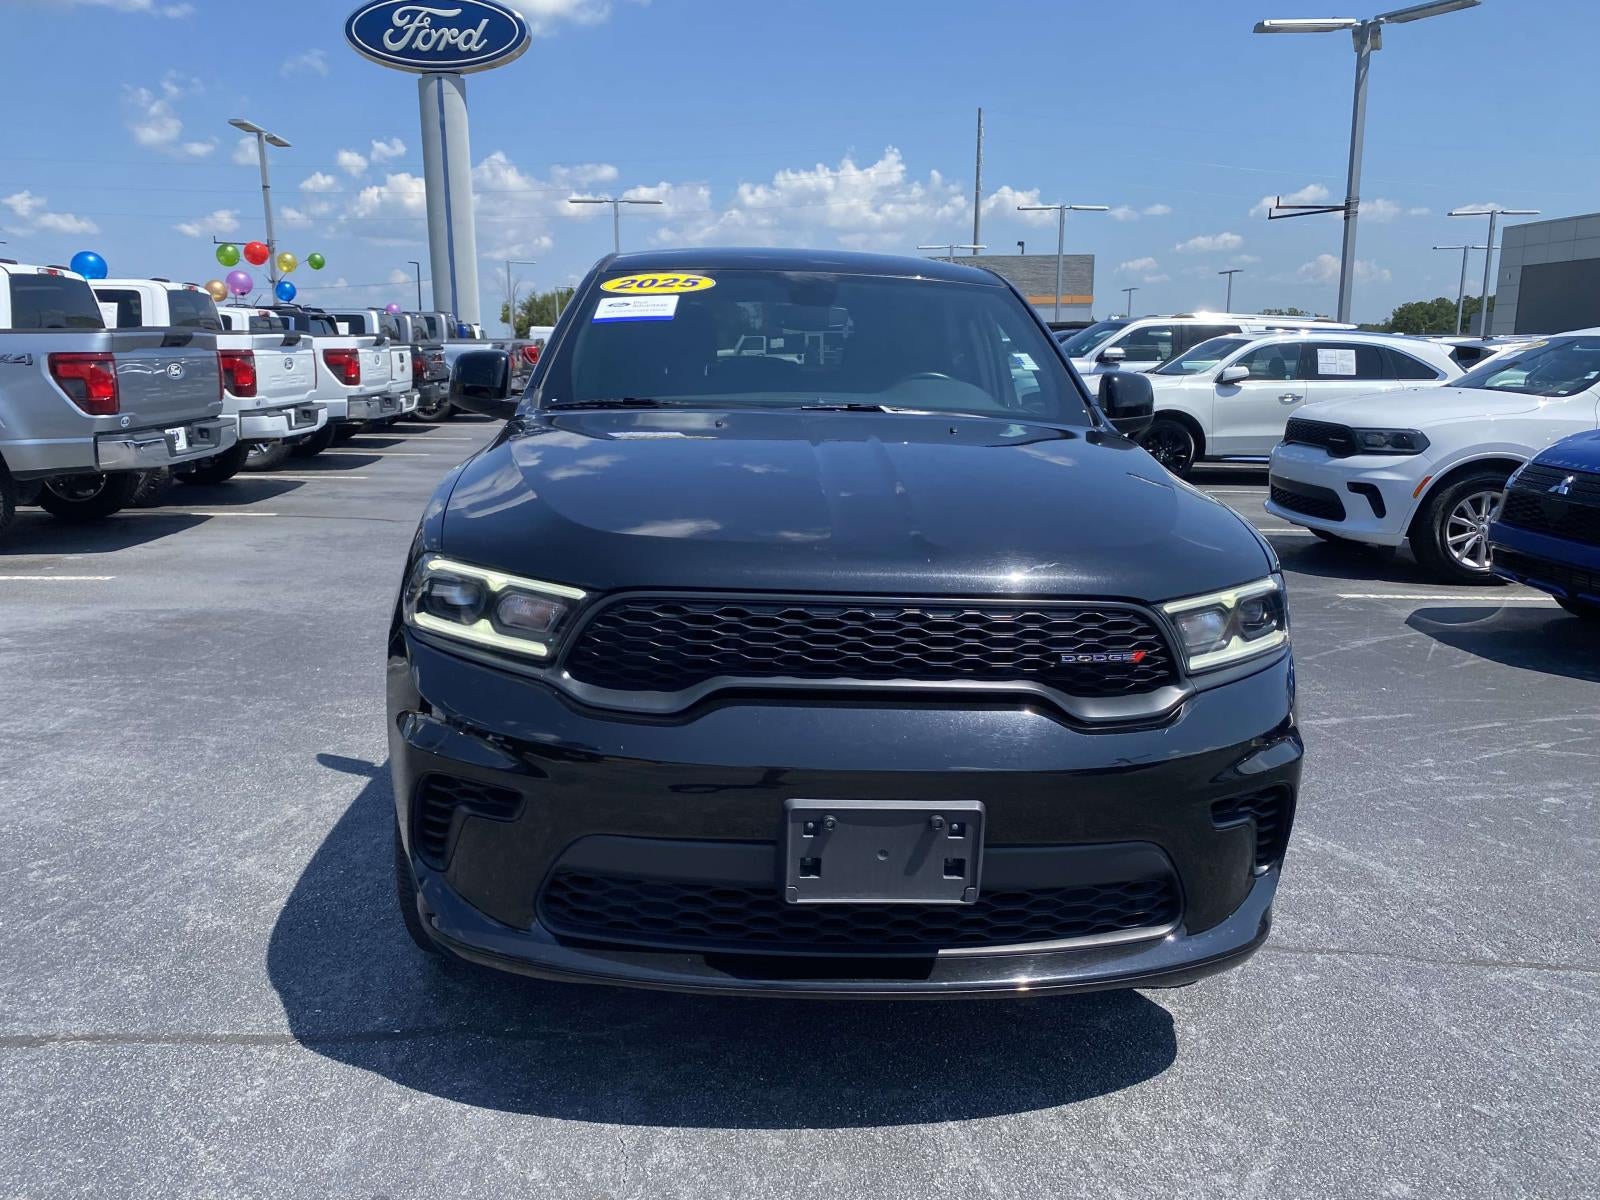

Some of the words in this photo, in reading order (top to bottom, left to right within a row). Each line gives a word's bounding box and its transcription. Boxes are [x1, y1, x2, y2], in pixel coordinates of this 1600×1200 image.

[383, 6, 489, 51] Ford
[612, 277, 703, 289] 2025
[1061, 654, 1131, 662] DODGE
